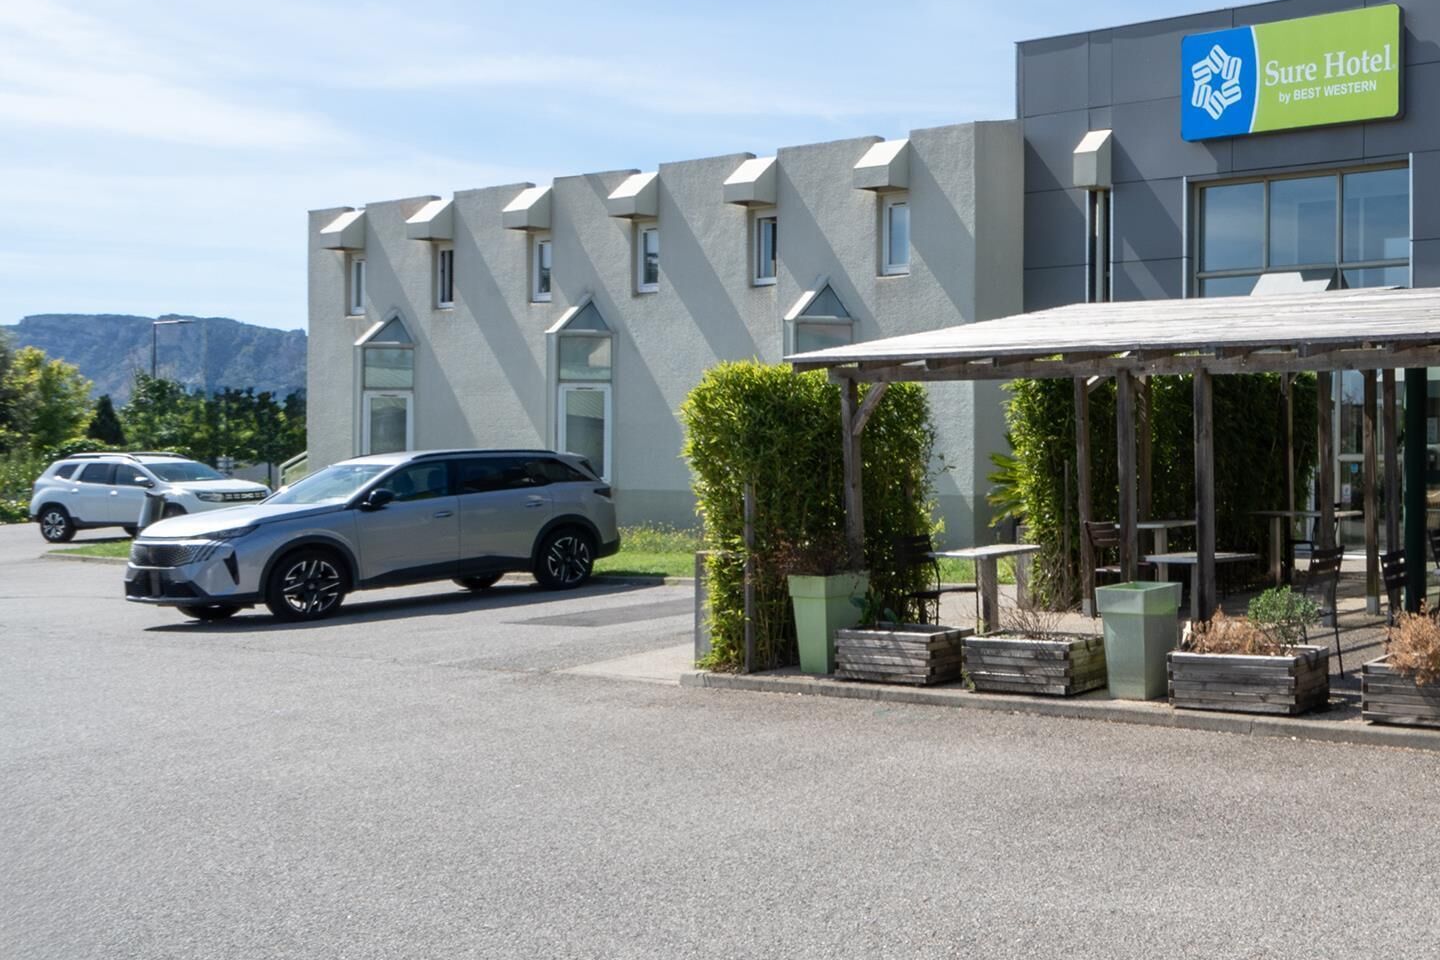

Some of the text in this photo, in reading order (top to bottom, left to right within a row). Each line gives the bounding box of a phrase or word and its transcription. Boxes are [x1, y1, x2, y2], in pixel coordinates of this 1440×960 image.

[1264, 44, 1393, 87] Sure Hotel
[1278, 80, 1377, 105] by BEST WESTERN
